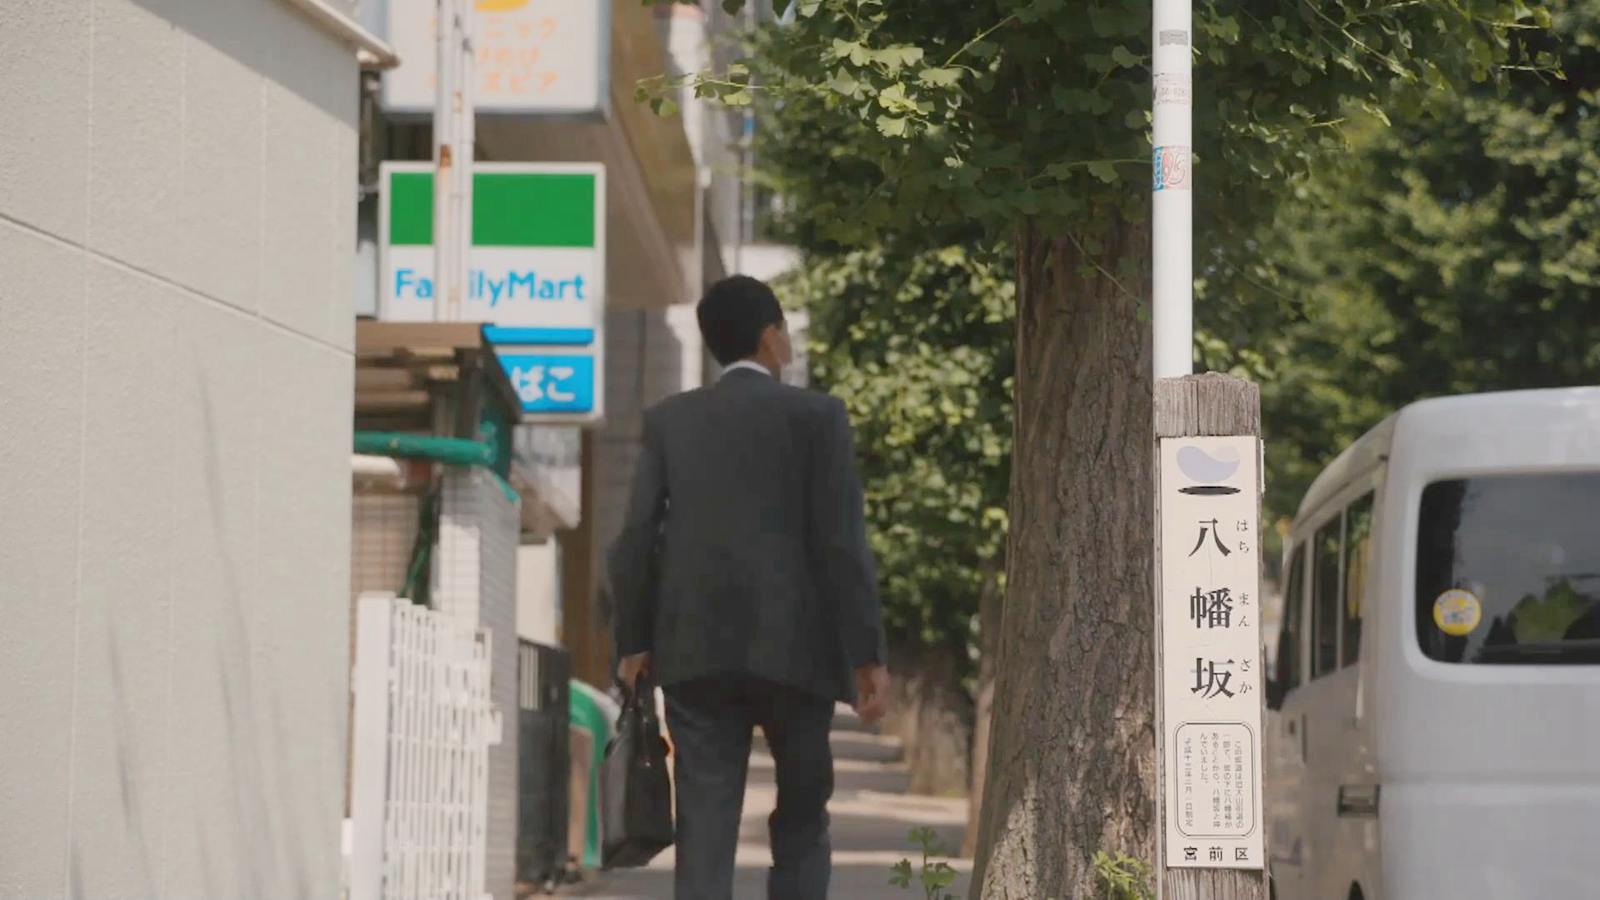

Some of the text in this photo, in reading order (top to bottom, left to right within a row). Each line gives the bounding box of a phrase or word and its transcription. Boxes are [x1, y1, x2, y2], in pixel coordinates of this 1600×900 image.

[395, 267, 585, 308] FailyMart
[1187, 517, 1236, 700] 八幡坂
[1183, 846, 1249, 862] 宮前区
